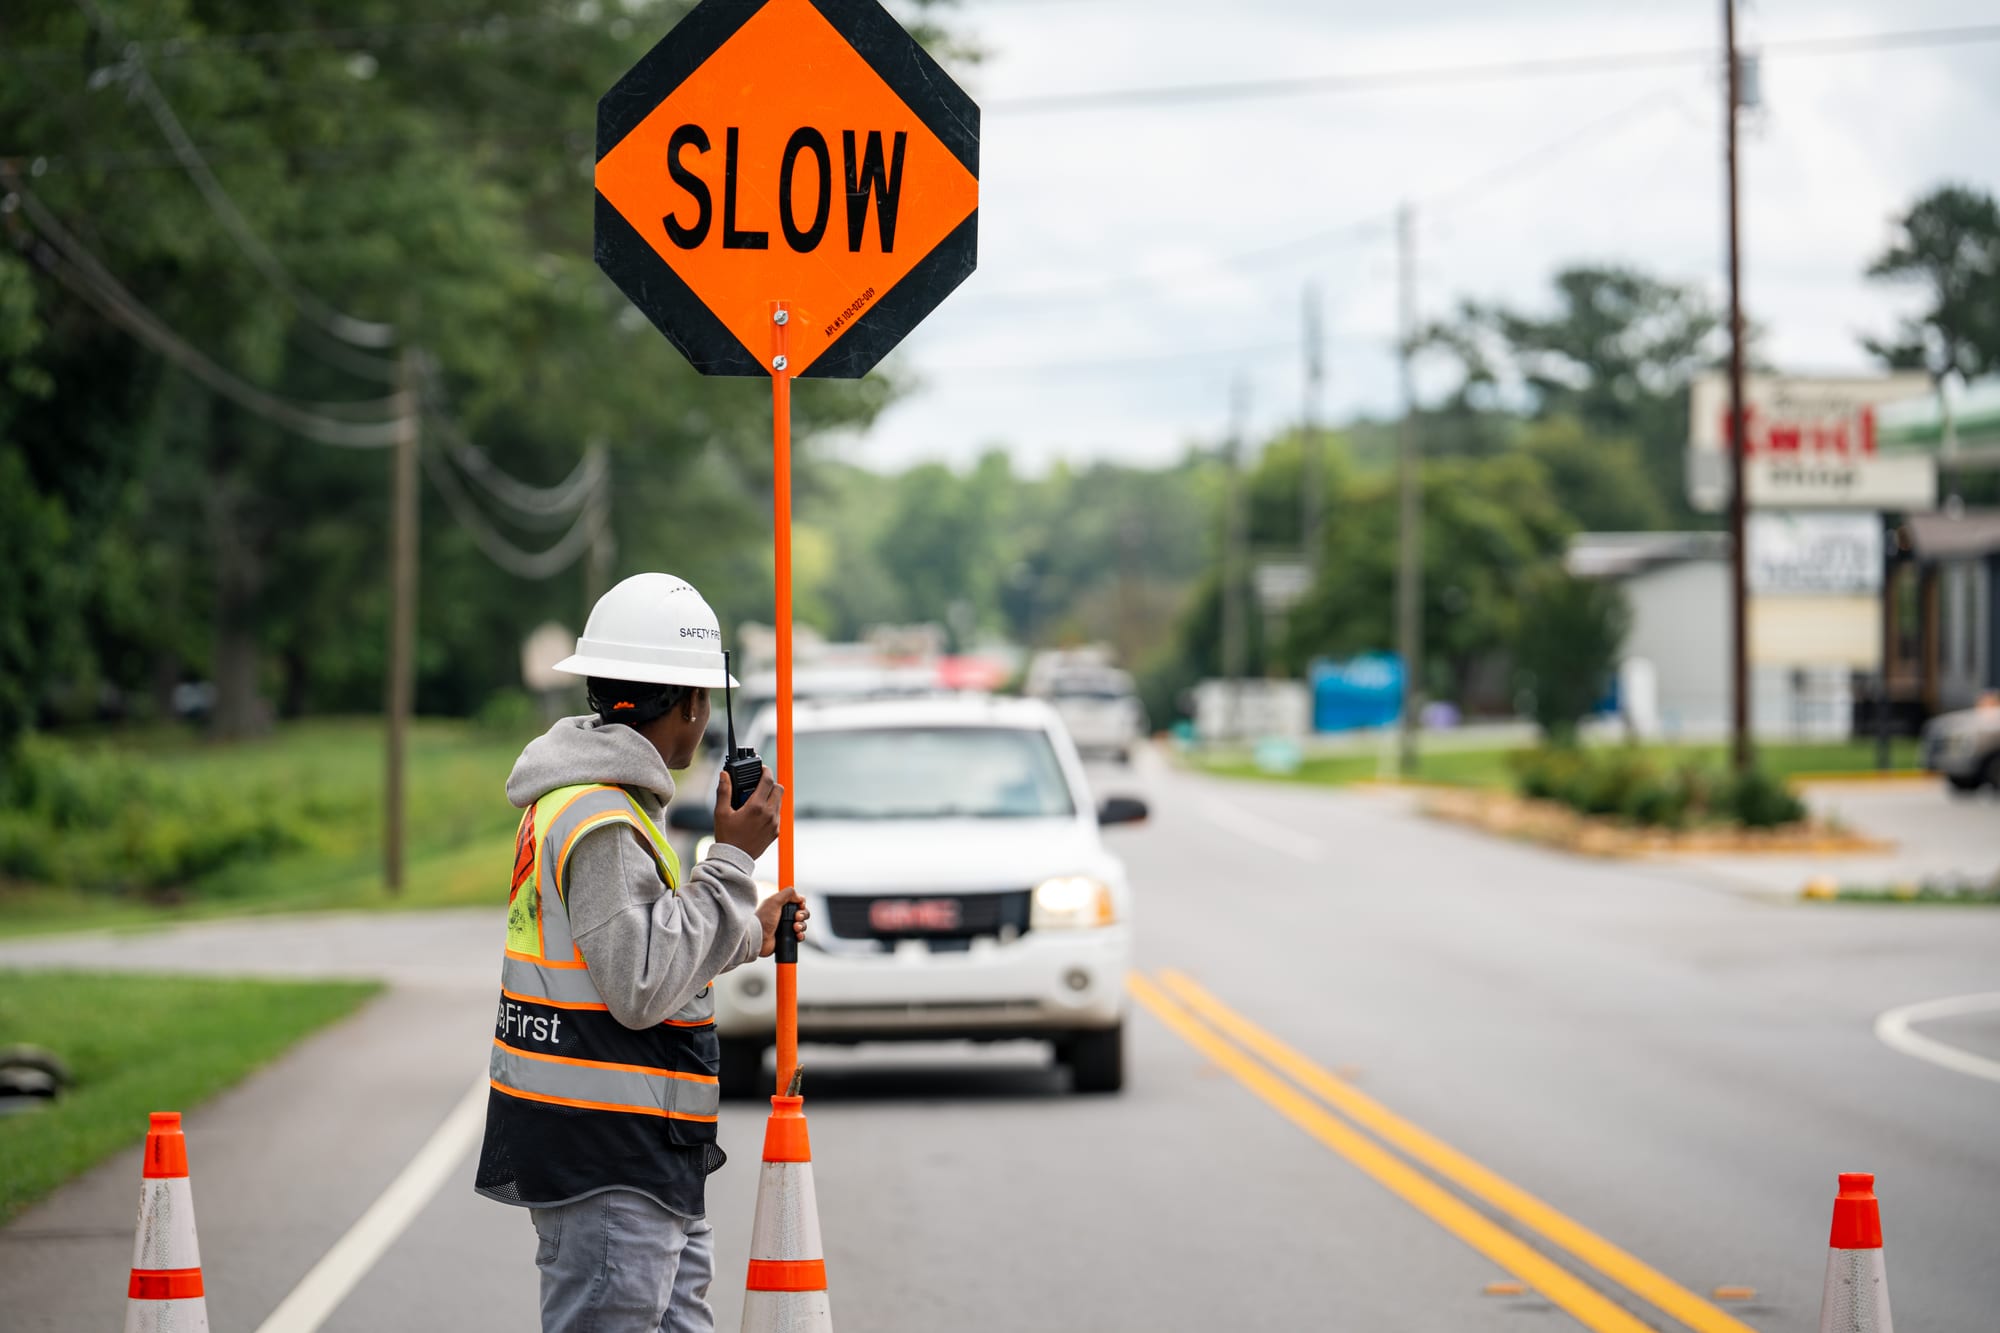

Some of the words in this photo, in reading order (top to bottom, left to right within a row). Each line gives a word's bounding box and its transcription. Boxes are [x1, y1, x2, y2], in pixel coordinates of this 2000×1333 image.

[662, 124, 907, 253] SLOW
[841, 287, 875, 320] 102-022-009
[680, 628, 710, 639] SAFETY
